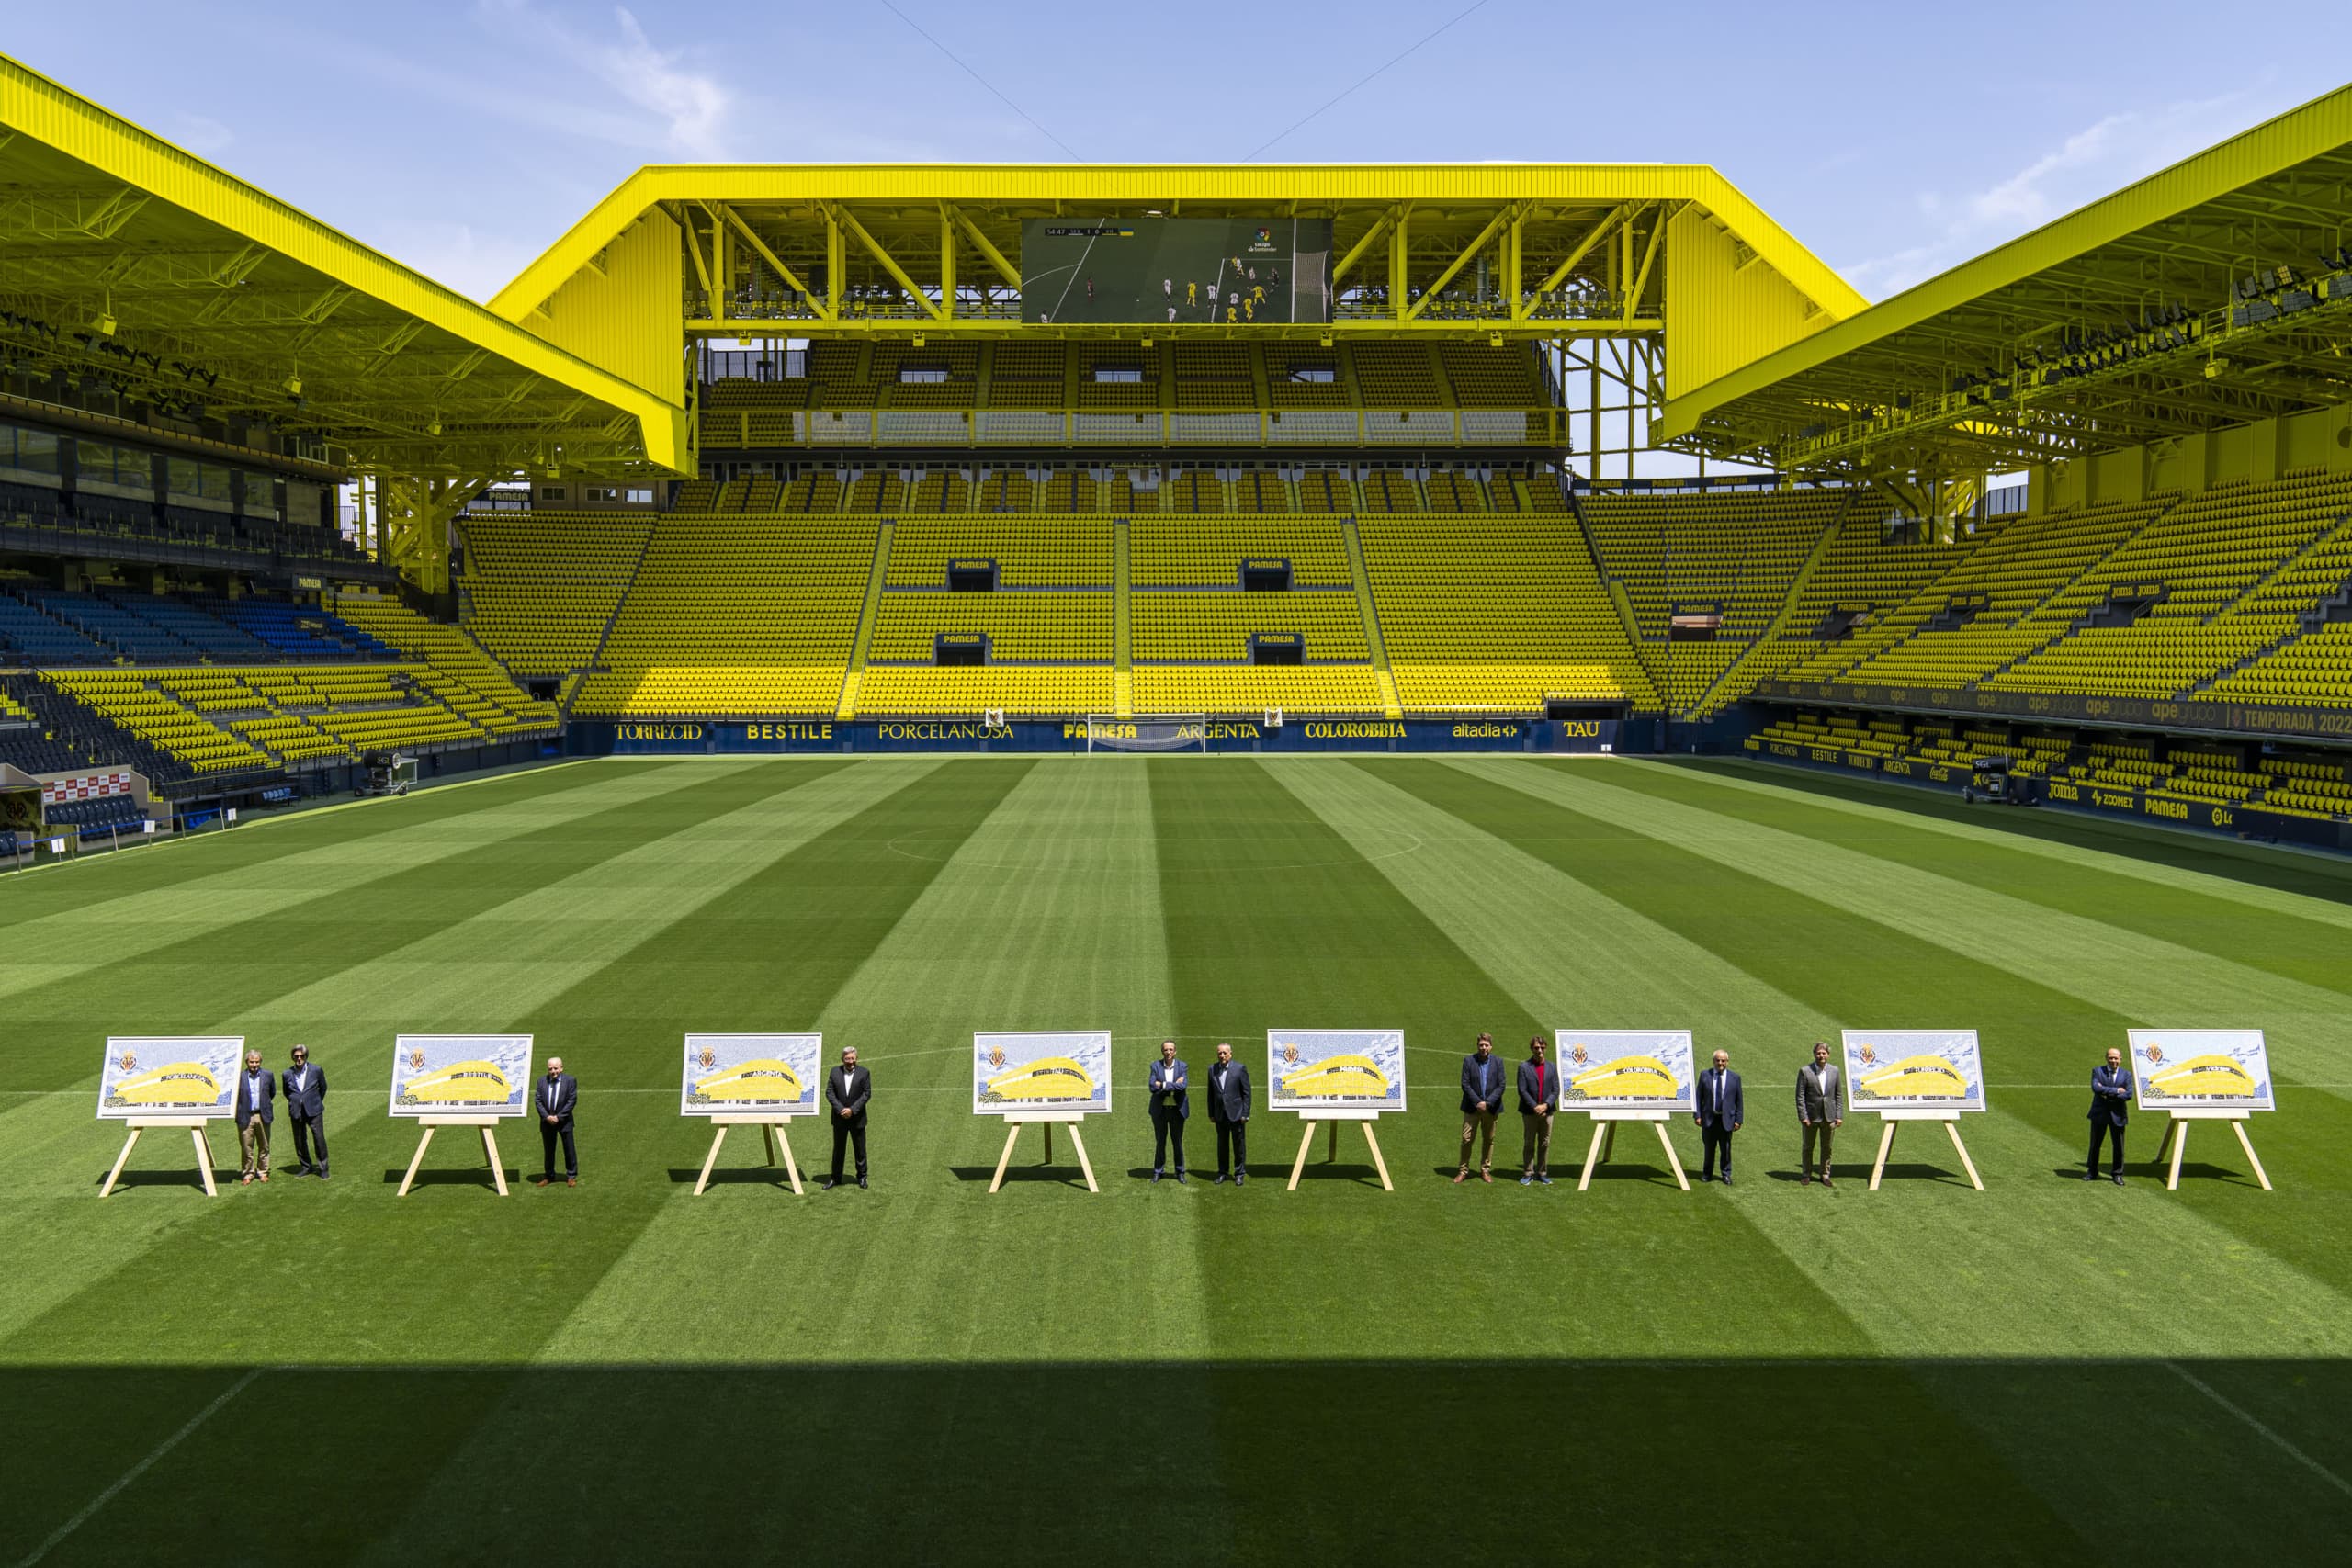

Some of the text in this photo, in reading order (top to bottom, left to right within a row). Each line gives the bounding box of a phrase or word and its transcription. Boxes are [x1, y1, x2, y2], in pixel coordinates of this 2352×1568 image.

[1250, 560, 1283, 569] PAMESA
[1679, 604, 1715, 613] PAMESA
[944, 635, 979, 643] PAMESA
[1259, 635, 1295, 643] PAMESA
[2245, 710, 2315, 731] TEMPORADA
[614, 724, 702, 739] TORRECID
[747, 724, 832, 739] BESTILE
[878, 723, 1014, 739] PORCELANOSA
[1064, 724, 1137, 739] PAMESA
[1176, 723, 1261, 739] ARGENTA
[1305, 722, 1407, 738] COLOROBBIA
[1453, 722, 1501, 738] altadia
[1563, 722, 1600, 738] TAU
[1812, 749, 1838, 763] BESTILE
[1883, 761, 1911, 775] ARGENTA
[2103, 794, 2134, 808] ZOOMEX
[2145, 798, 2188, 819] PAMESA
